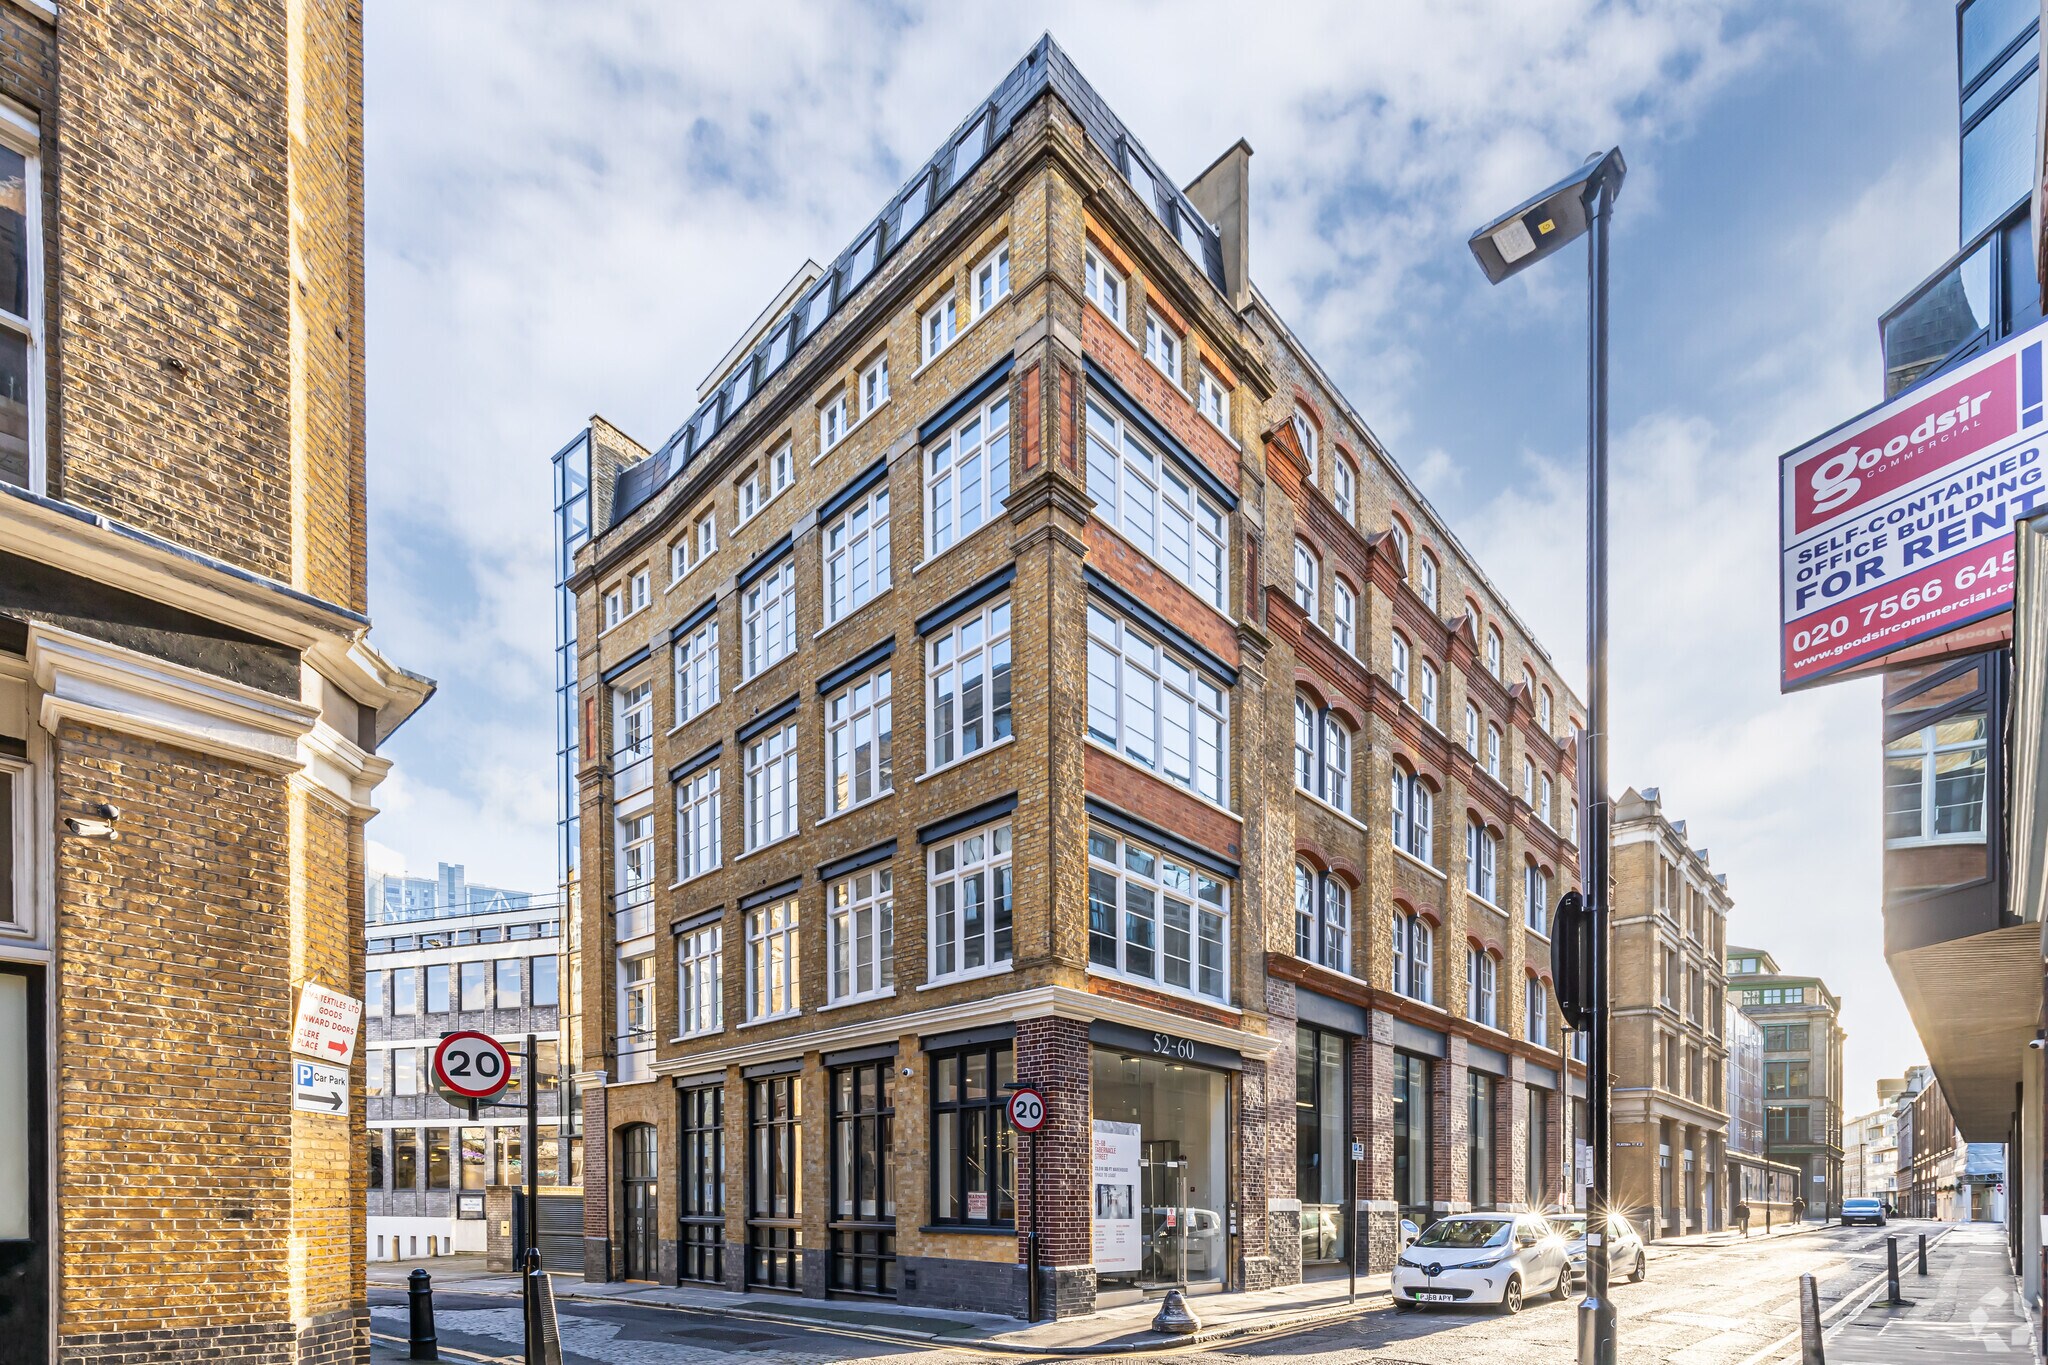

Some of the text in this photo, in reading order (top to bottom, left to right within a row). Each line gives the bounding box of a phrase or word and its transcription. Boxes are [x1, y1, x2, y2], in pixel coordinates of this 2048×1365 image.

[1811, 390, 1992, 514] goodsir
[1866, 420, 1981, 478] COMMERCIAL
[1798, 447, 2040, 564] SELF-CONTAINED
[1796, 467, 2042, 583] OFFICE BUILDING
[1796, 484, 2046, 611] FOR RENT
[1793, 616, 1849, 652] 020
[1860, 579, 1942, 627] 7566
[319, 1006, 343, 1020] GOODS
[320, 994, 347, 1010] TEXTILES
[348, 1004, 360, 1014] LTD
[299, 1028, 320, 1040] CLERE
[302, 1013, 355, 1035] INWARD DOORS
[297, 1037, 319, 1051] PLACE
[1153, 1033, 1195, 1060] 52-60
[300, 1065, 346, 1086] P Car Park
[447, 1050, 500, 1078] 20
[1016, 1100, 1042, 1120] 20
